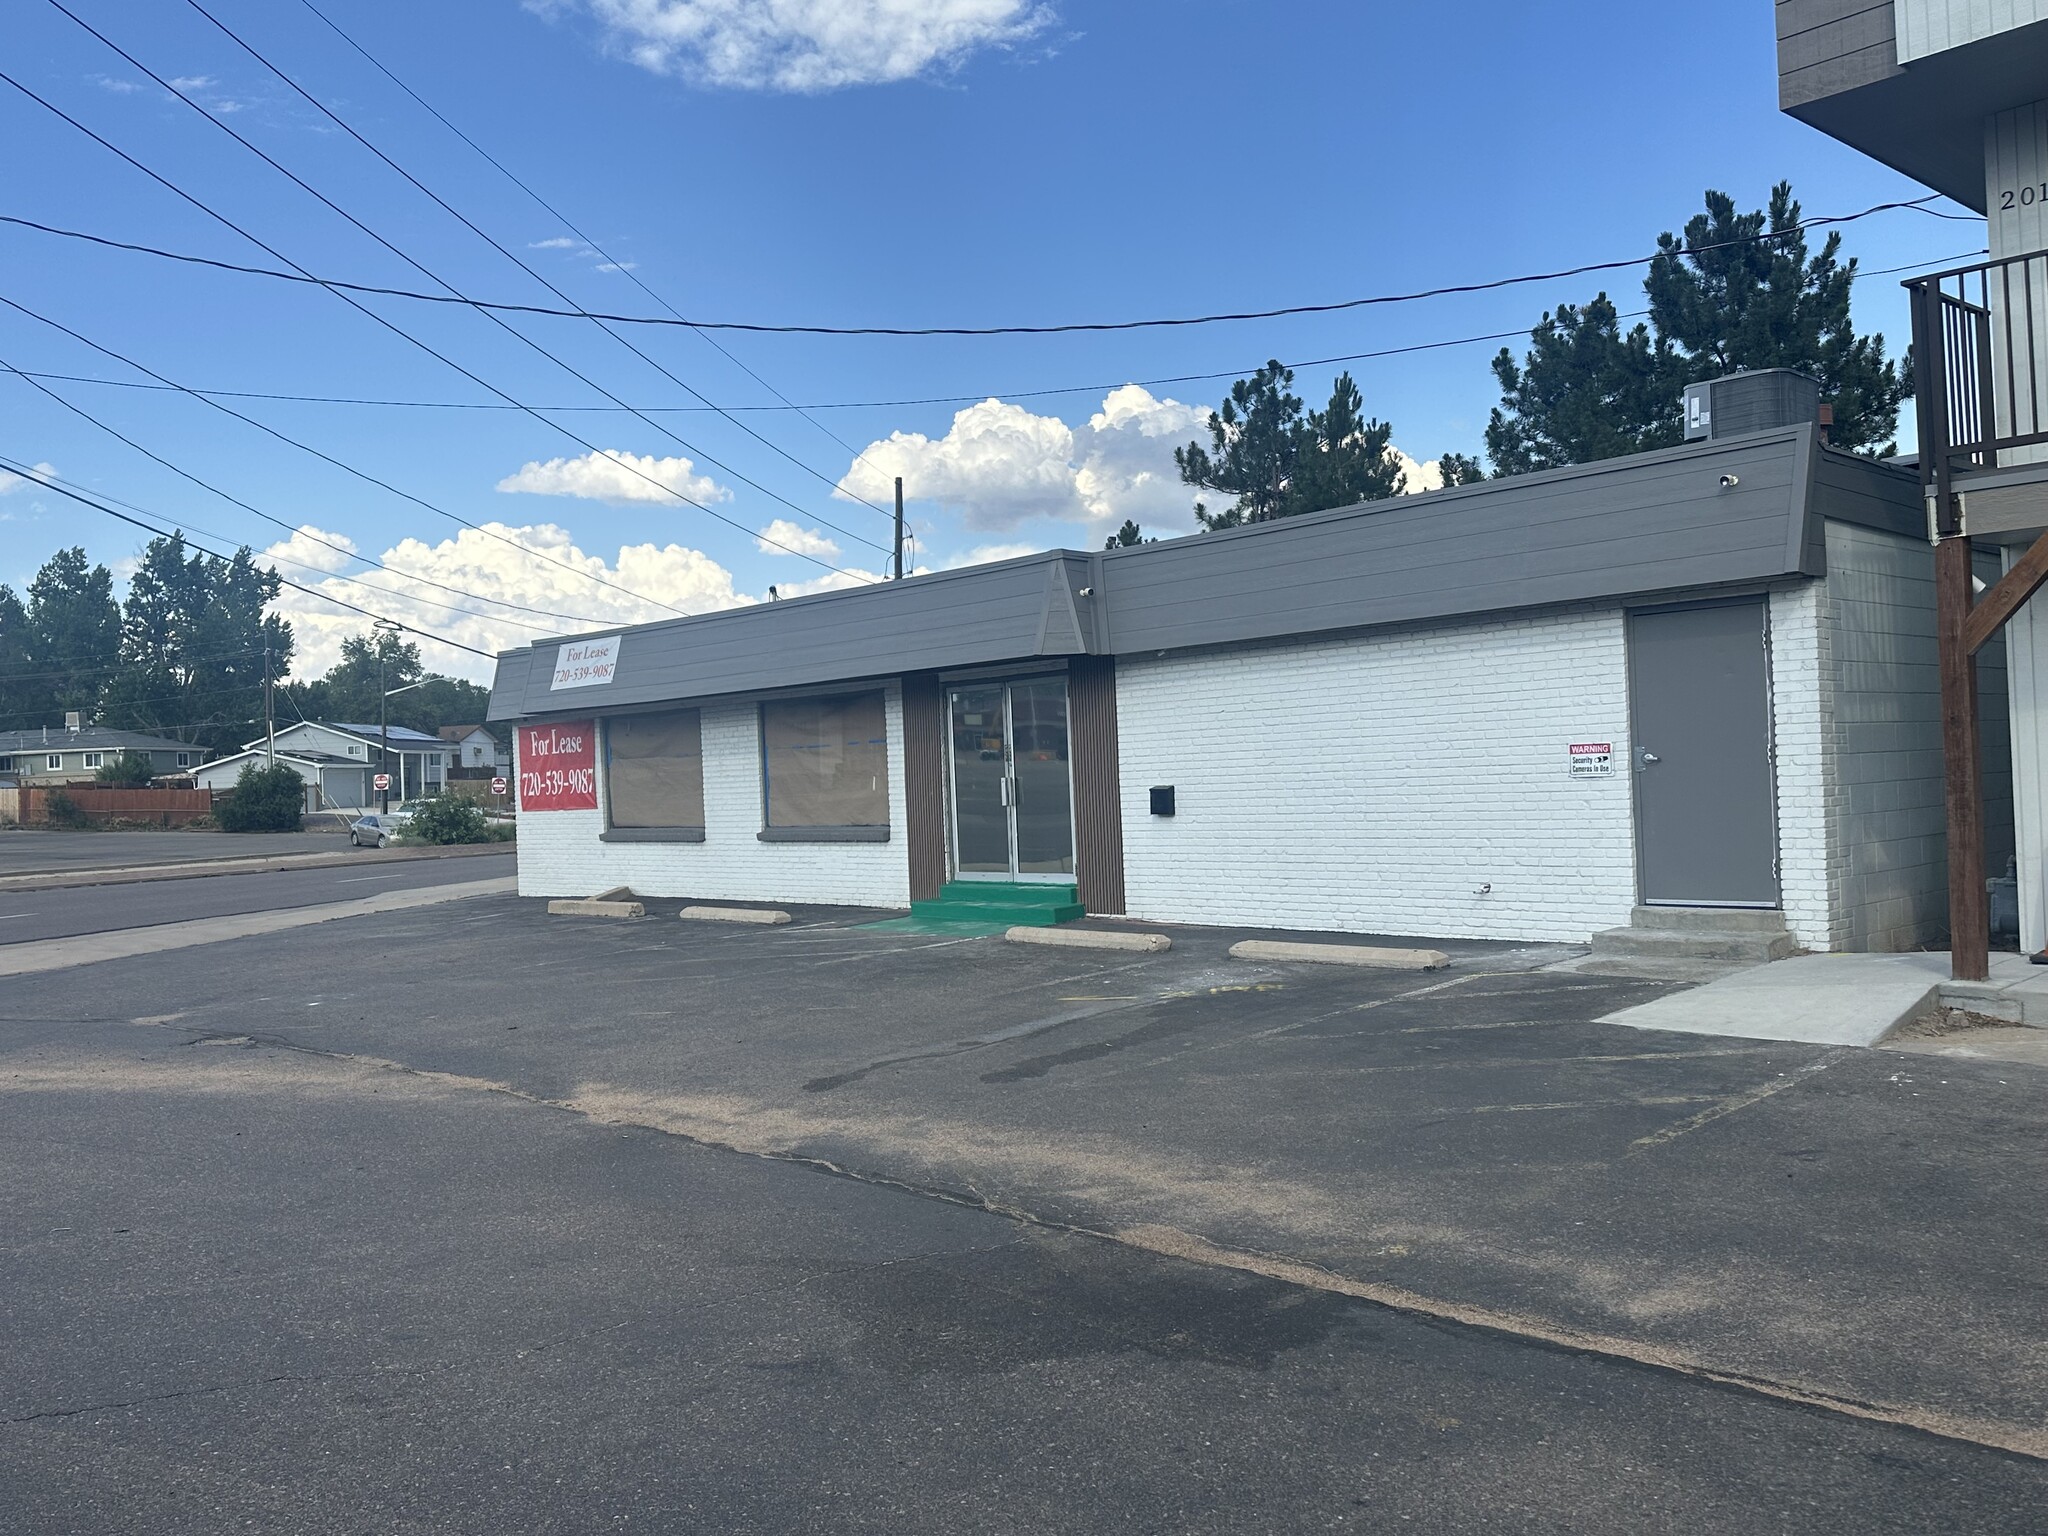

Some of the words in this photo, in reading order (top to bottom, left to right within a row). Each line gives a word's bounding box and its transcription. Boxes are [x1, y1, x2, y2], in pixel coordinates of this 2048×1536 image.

[2001, 183, 2048, 210] 201
[567, 647, 583, 662] For
[583, 646, 609, 660] Lease
[554, 663, 615, 683] 720-539-9087
[530, 731, 550, 756] For
[551, 729, 583, 754] Lease
[1571, 744, 1609, 753] WARNING
[1572, 756, 1593, 764] Security
[522, 768, 594, 796] 720-539-9087
